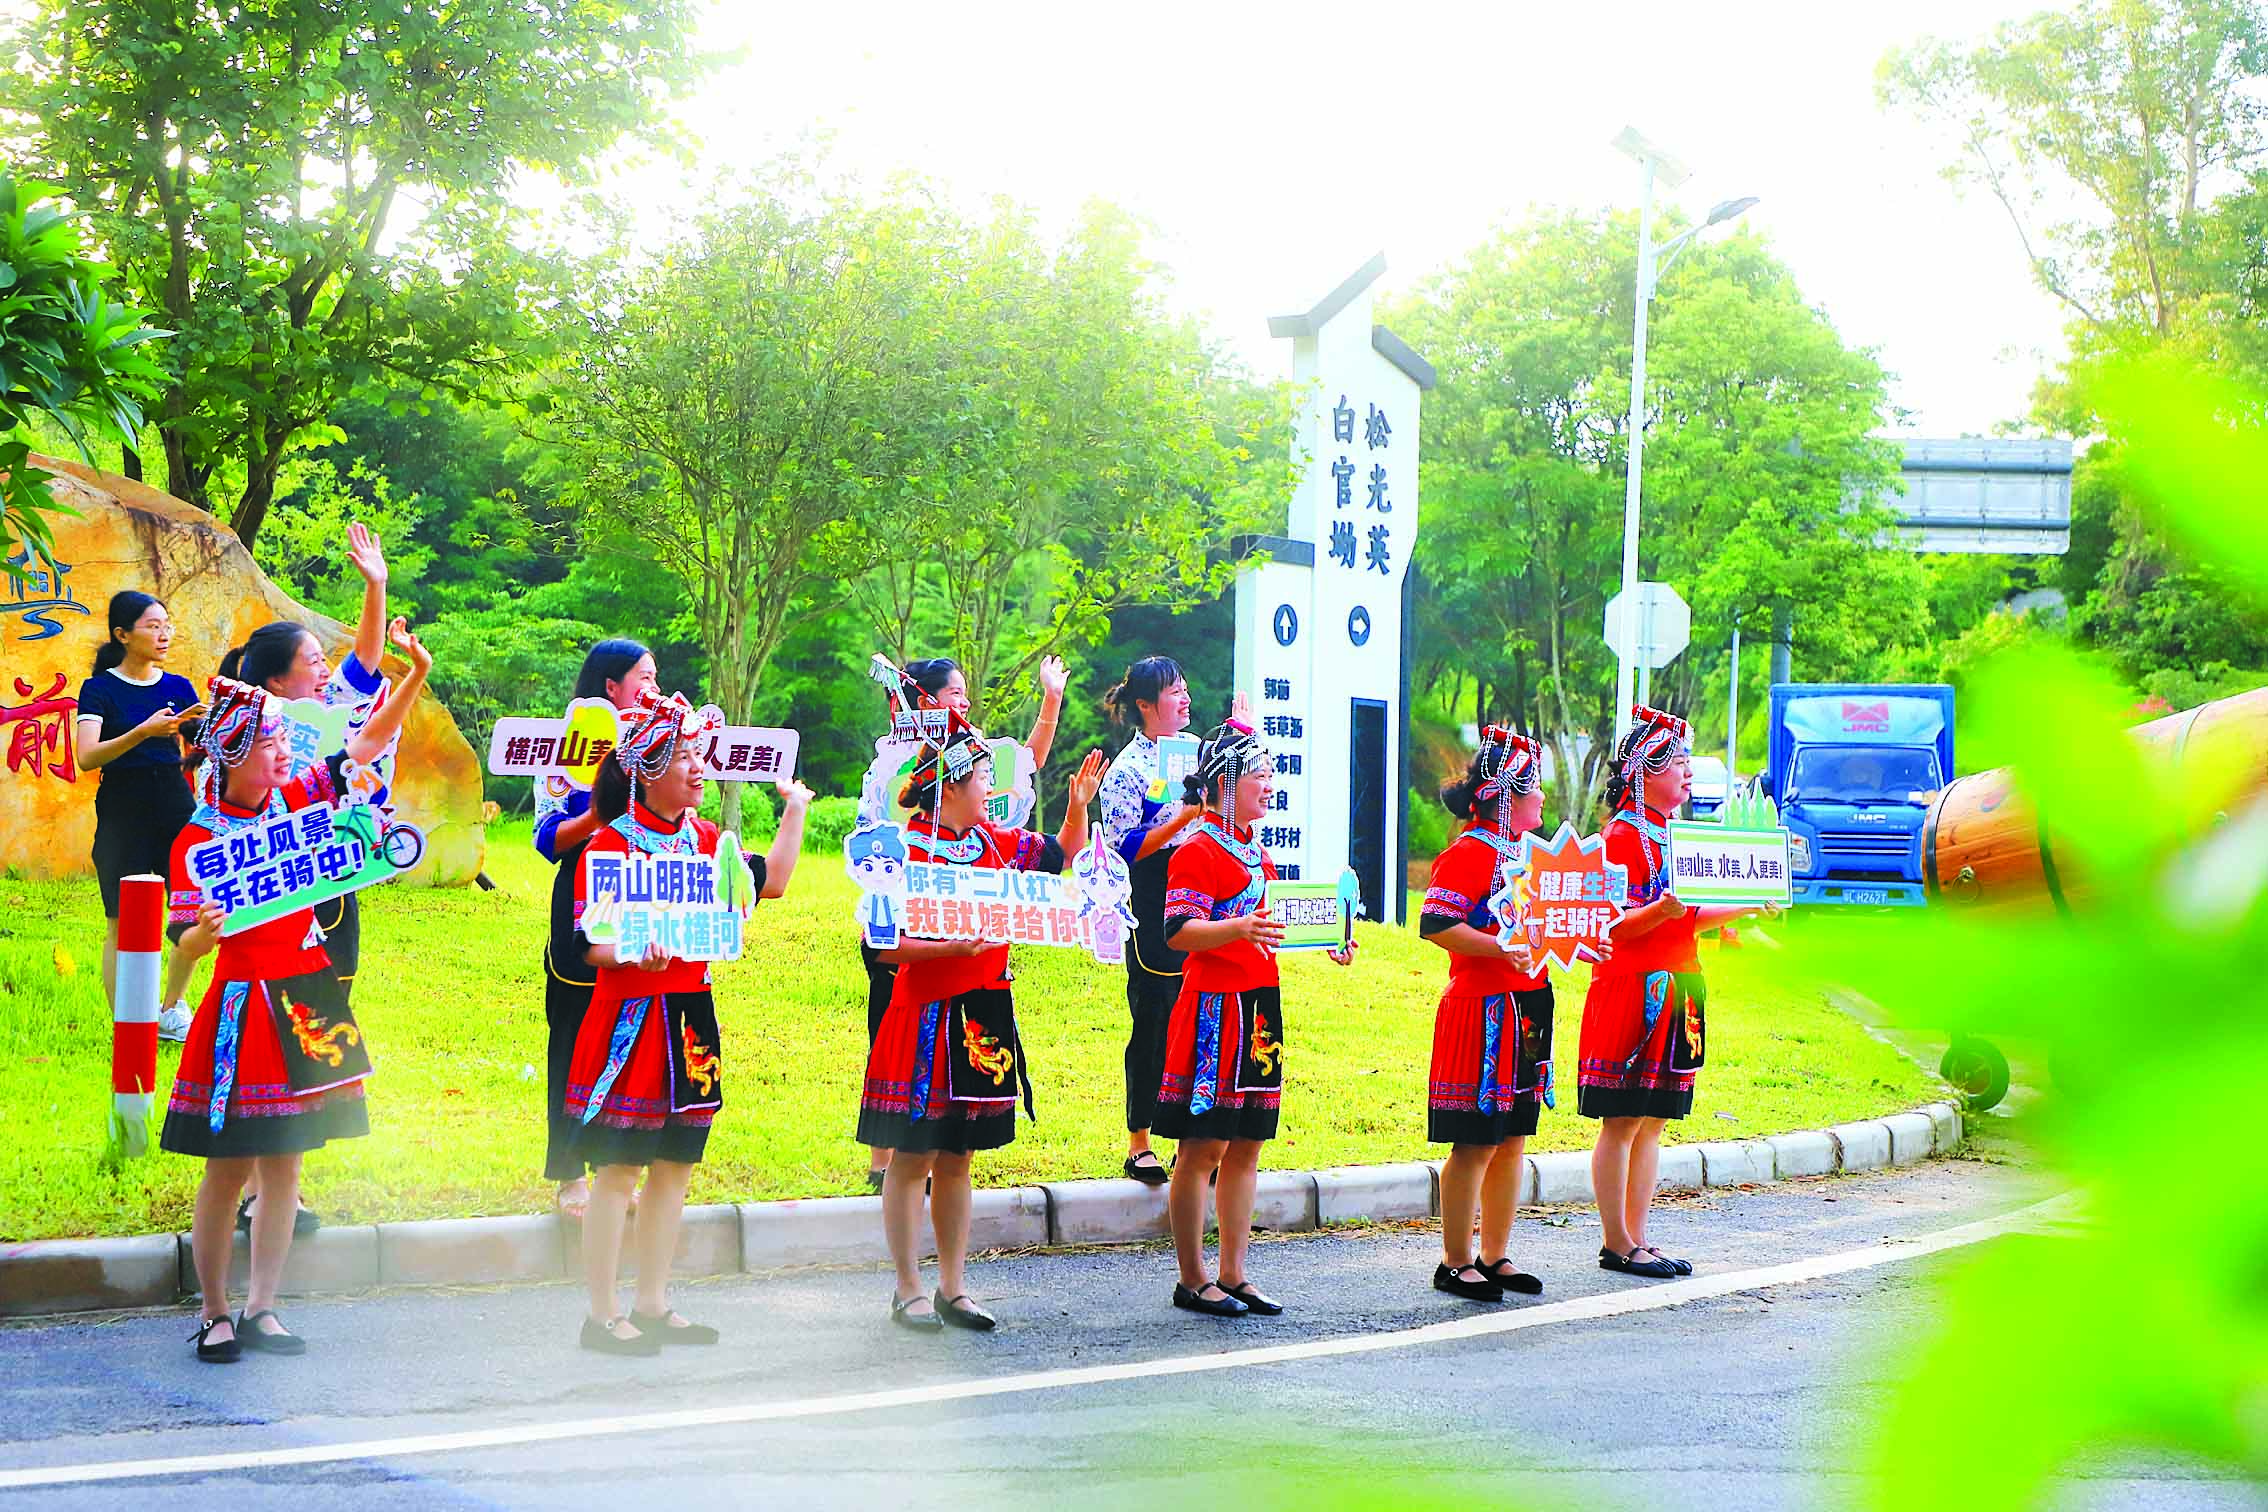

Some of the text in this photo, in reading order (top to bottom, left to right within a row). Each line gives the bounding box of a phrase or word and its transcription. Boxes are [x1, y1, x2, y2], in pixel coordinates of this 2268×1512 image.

[1364, 402, 1393, 575] 松光英
[1264, 677, 1290, 701] 郭前
[0, 672, 78, 784] 前
[282, 716, 321, 759] 实
[1842, 723, 1889, 733] JMC
[505, 731, 783, 773] 横河山美 人更美!
[1270, 753, 1302, 775] 布围
[1261, 826, 1301, 848] 老圩村
[1847, 813, 1887, 824] JMC
[193, 806, 335, 879] 每处风景
[210, 842, 364, 915] 乐在骑中!
[592, 858, 715, 905] 两山明珠
[1539, 869, 1626, 901] 健康生活
[619, 911, 740, 955] 绿水横河
[905, 898, 1093, 945] 我就嫁给你!
[1523, 907, 1611, 938] 一起骑行
